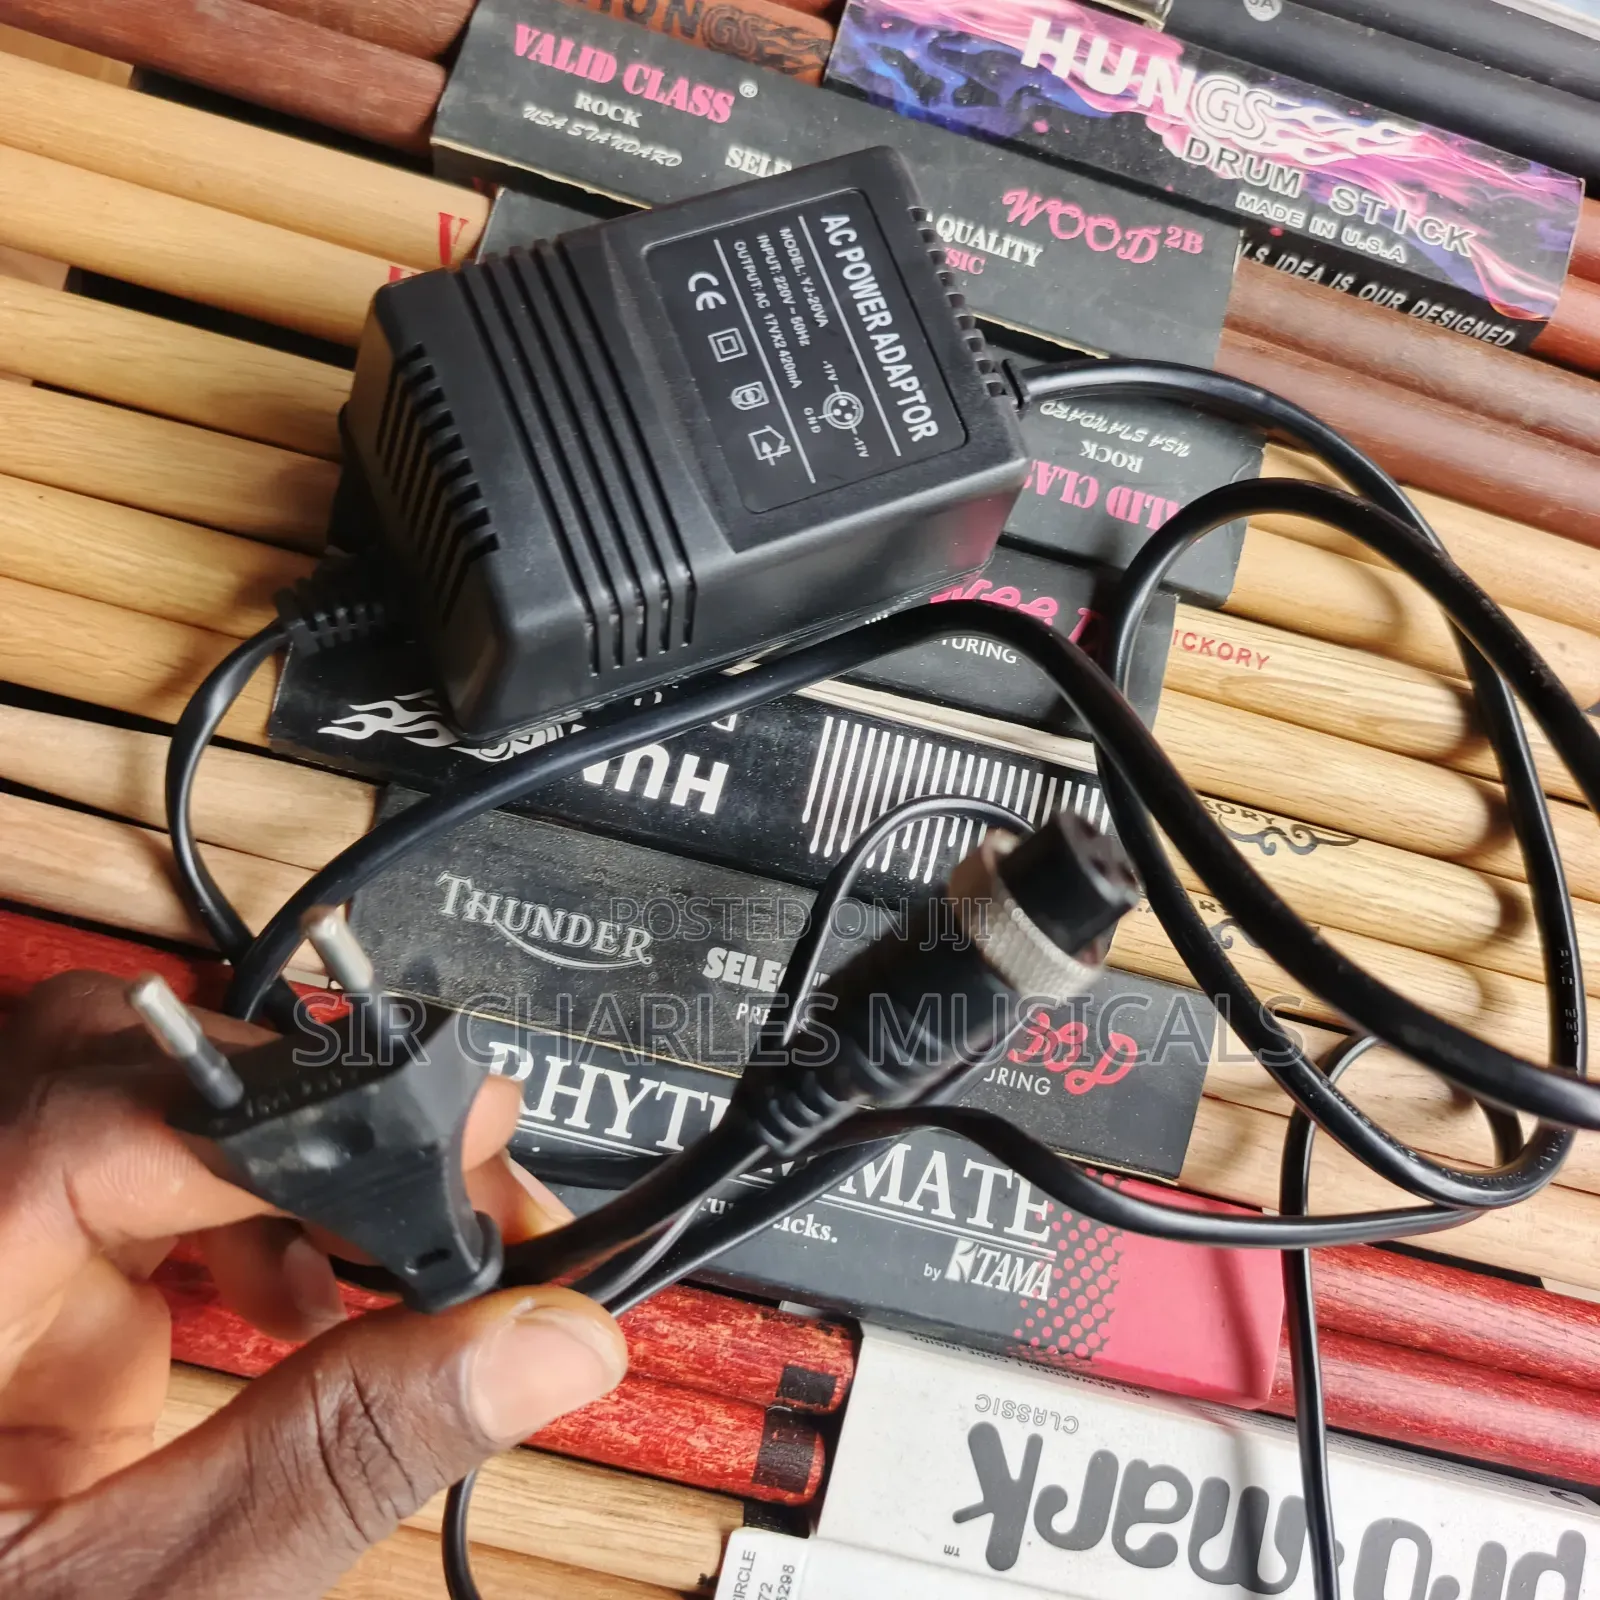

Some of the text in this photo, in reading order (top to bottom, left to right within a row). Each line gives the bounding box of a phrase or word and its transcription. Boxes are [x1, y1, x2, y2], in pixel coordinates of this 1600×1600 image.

[513, 23, 736, 124] VALID CLASS
[1020, 16, 1275, 142] HUNGS
[522, 105, 684, 168] USA STANDARD
[573, 92, 643, 129] ROCK
[1181, 135, 1475, 257] DRUM STICK
[779, 228, 808, 277] MODEL:
[935, 213, 1044, 268] QUALITY
[1002, 187, 1205, 264] WOOD 2B
[1235, 191, 1409, 265] MADE IN U.S.A
[756, 234, 782, 275] INPUT:
[773, 275, 797, 305] 220V
[944, 247, 986, 276] SIC
[820, 214, 939, 443] AC POWER ADAPTOR
[1274, 254, 1328, 285] IDEA
[1329, 271, 1355, 293] IS
[1358, 282, 1410, 310] OUR
[1408, 299, 1517, 348] DESIGNED
[777, 349, 803, 389] 420mA
[1039, 400, 1193, 458] USA STANDARD
[1079, 440, 1145, 473] ROCK
[1023, 459, 1100, 510] CLA
[1172, 628, 1271, 671] ICKORY
[434, 870, 653, 966] THUNDER
[702, 946, 788, 993] SELE
[488, 1041, 732, 1152] RHYT
[923, 1247, 1053, 1301] by TAMA
[974, 1393, 1080, 1434] CLASSIC
